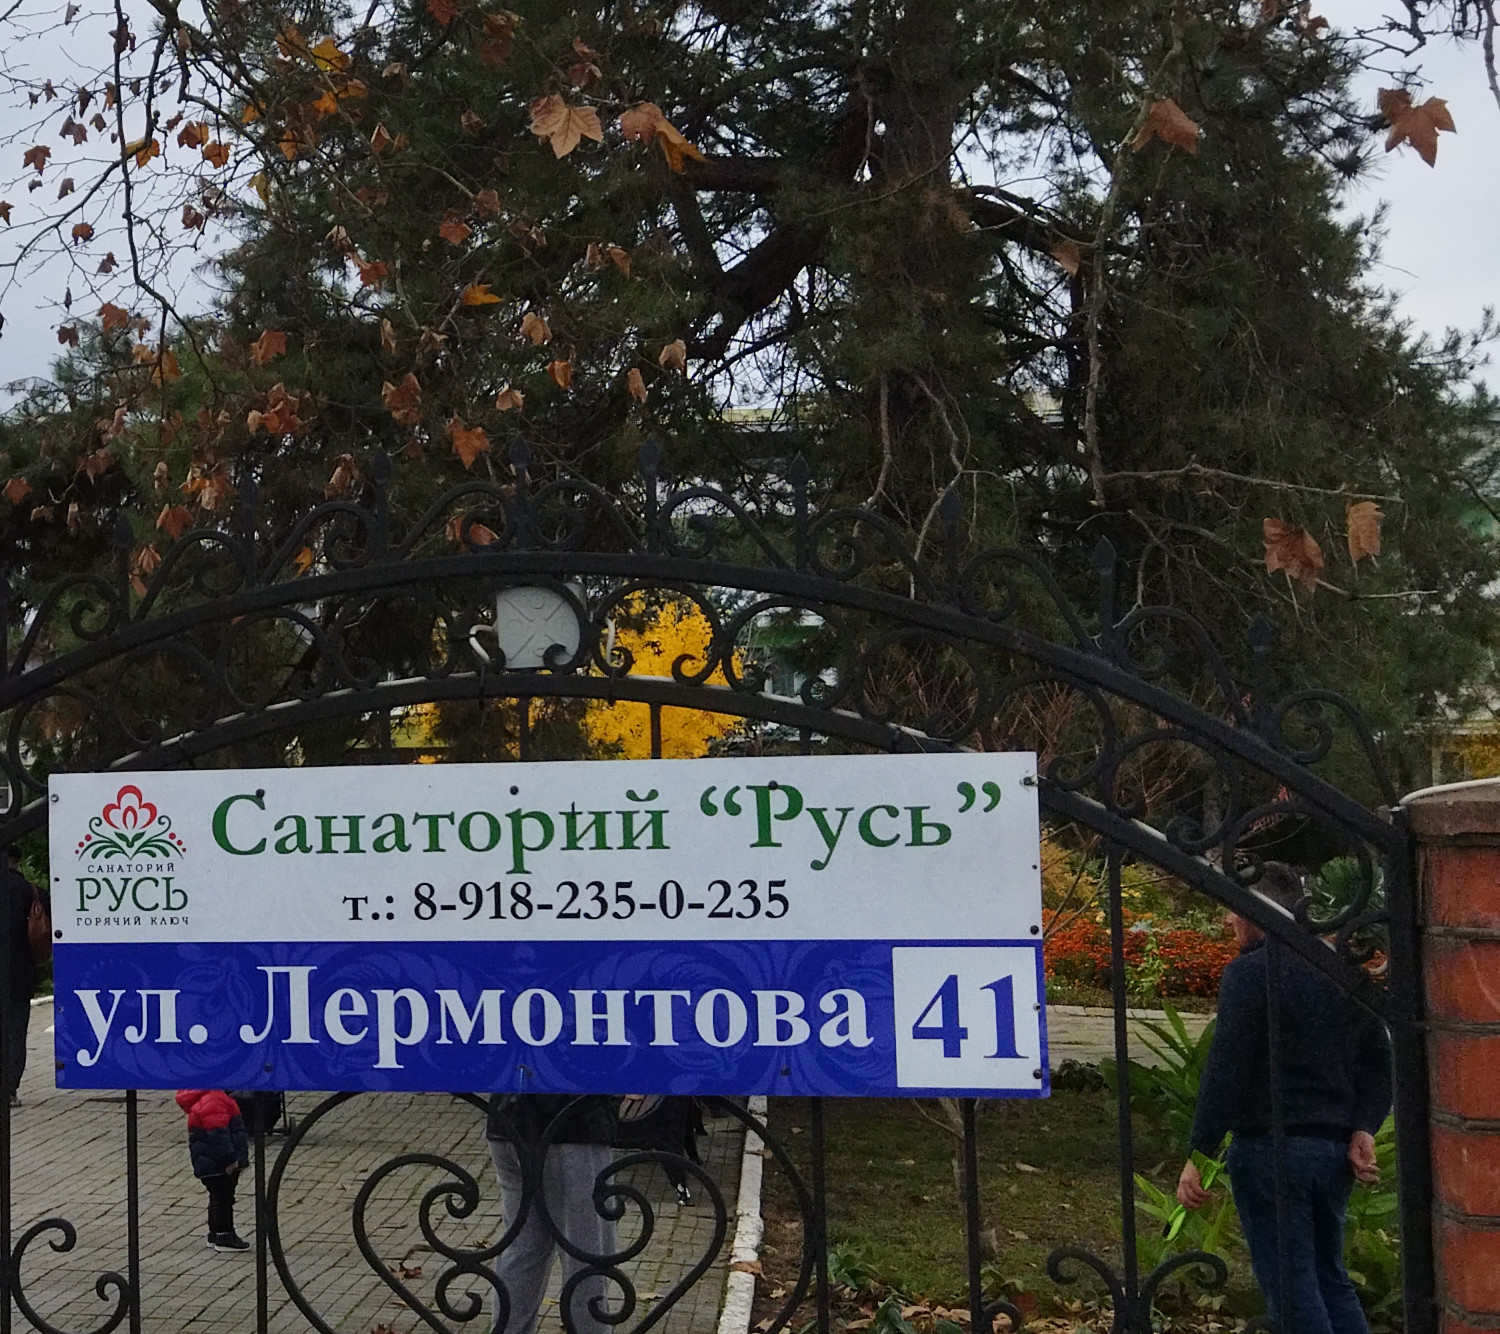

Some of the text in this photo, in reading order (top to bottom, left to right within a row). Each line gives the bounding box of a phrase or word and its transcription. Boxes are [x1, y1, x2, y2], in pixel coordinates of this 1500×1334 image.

[212, 788, 670, 874] Санаторий
[87, 862, 175, 874] САНАТОРИЙ
[75, 876, 189, 913] РУСЬ
[413, 879, 790, 921] 8-918-235-0-235
[76, 915, 190, 927] ГОРЯЧИЙ КЛЮЧ
[74, 966, 1030, 1069] ул. Лермонтова 41
